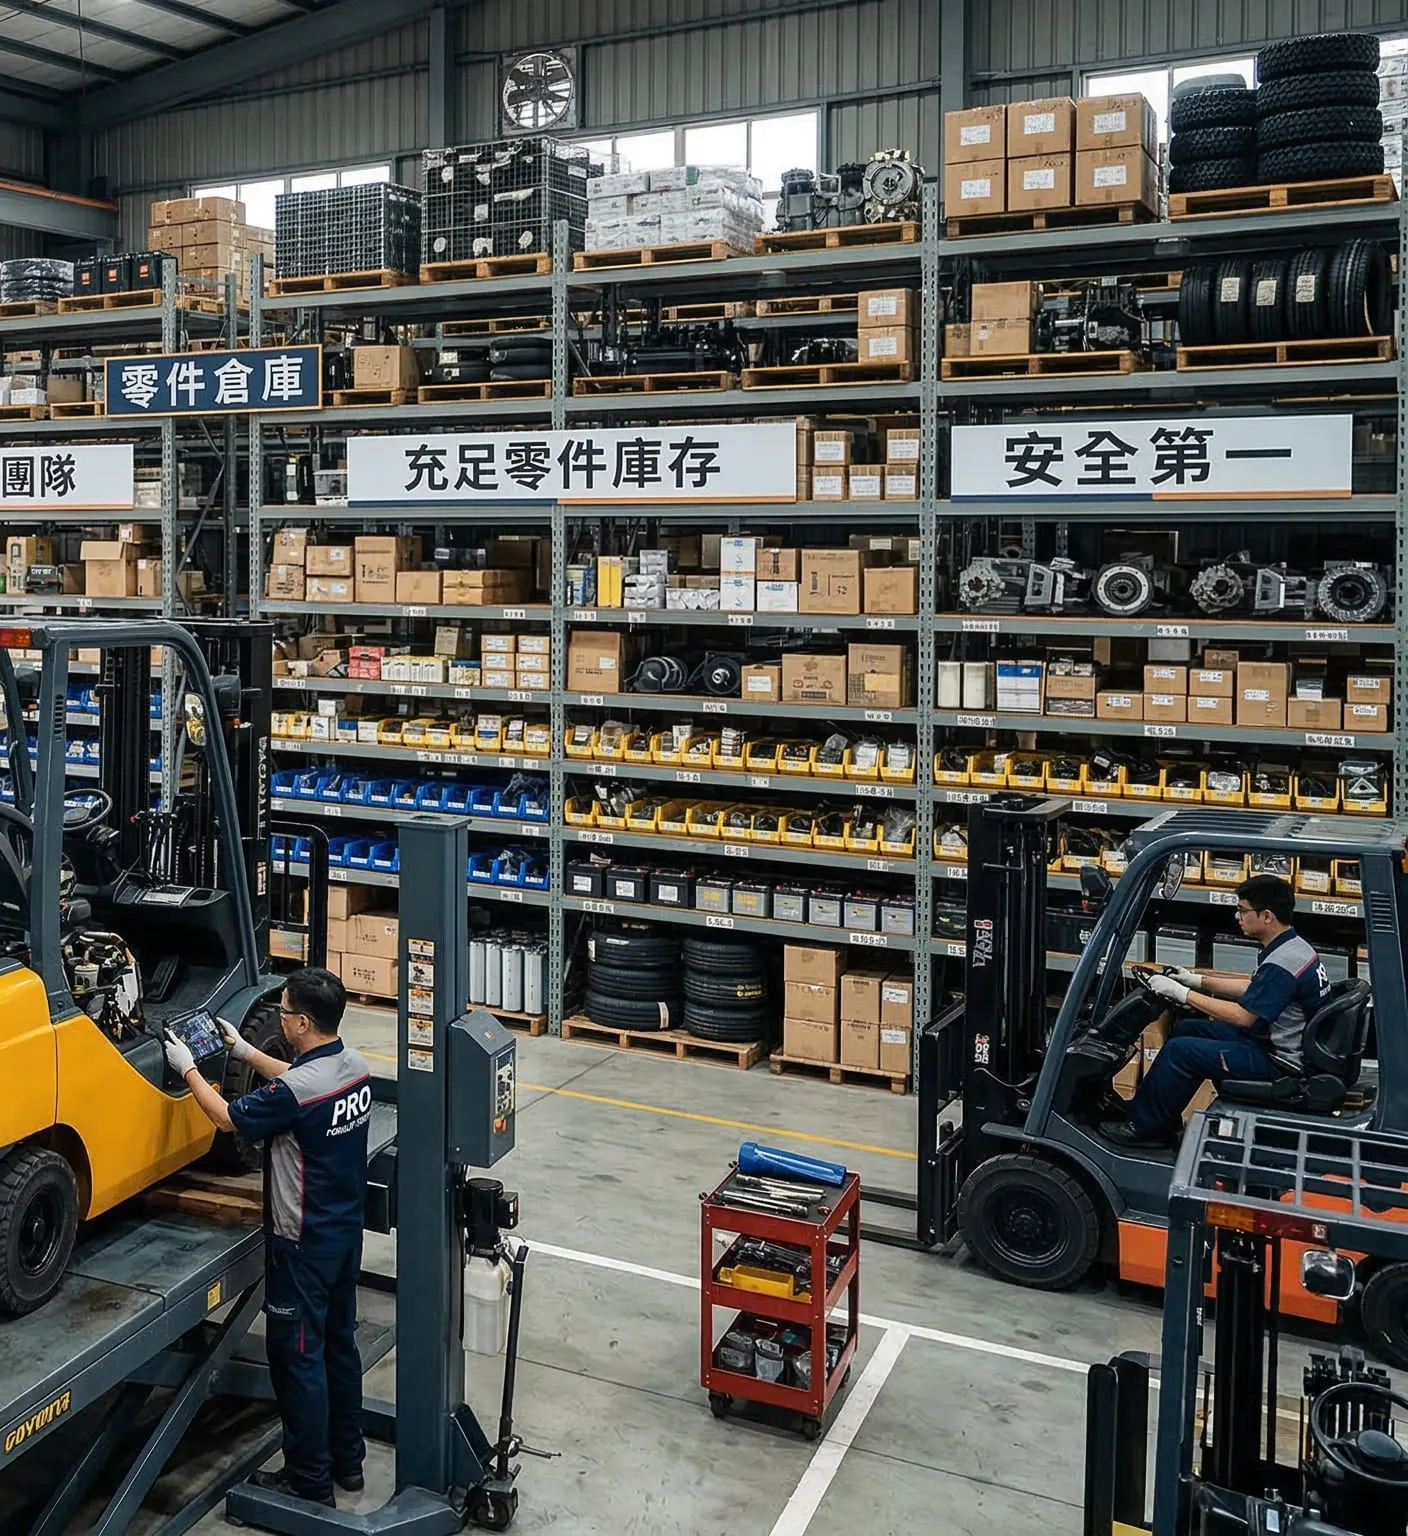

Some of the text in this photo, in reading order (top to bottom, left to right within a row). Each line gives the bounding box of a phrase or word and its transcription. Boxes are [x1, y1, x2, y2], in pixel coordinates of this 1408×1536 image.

[120, 354, 304, 409] 零件倉庫
[404, 436, 721, 492] 充足零件庫存
[1004, 426, 1292, 488] 安全第一
[332, 1085, 371, 1126] PRO
